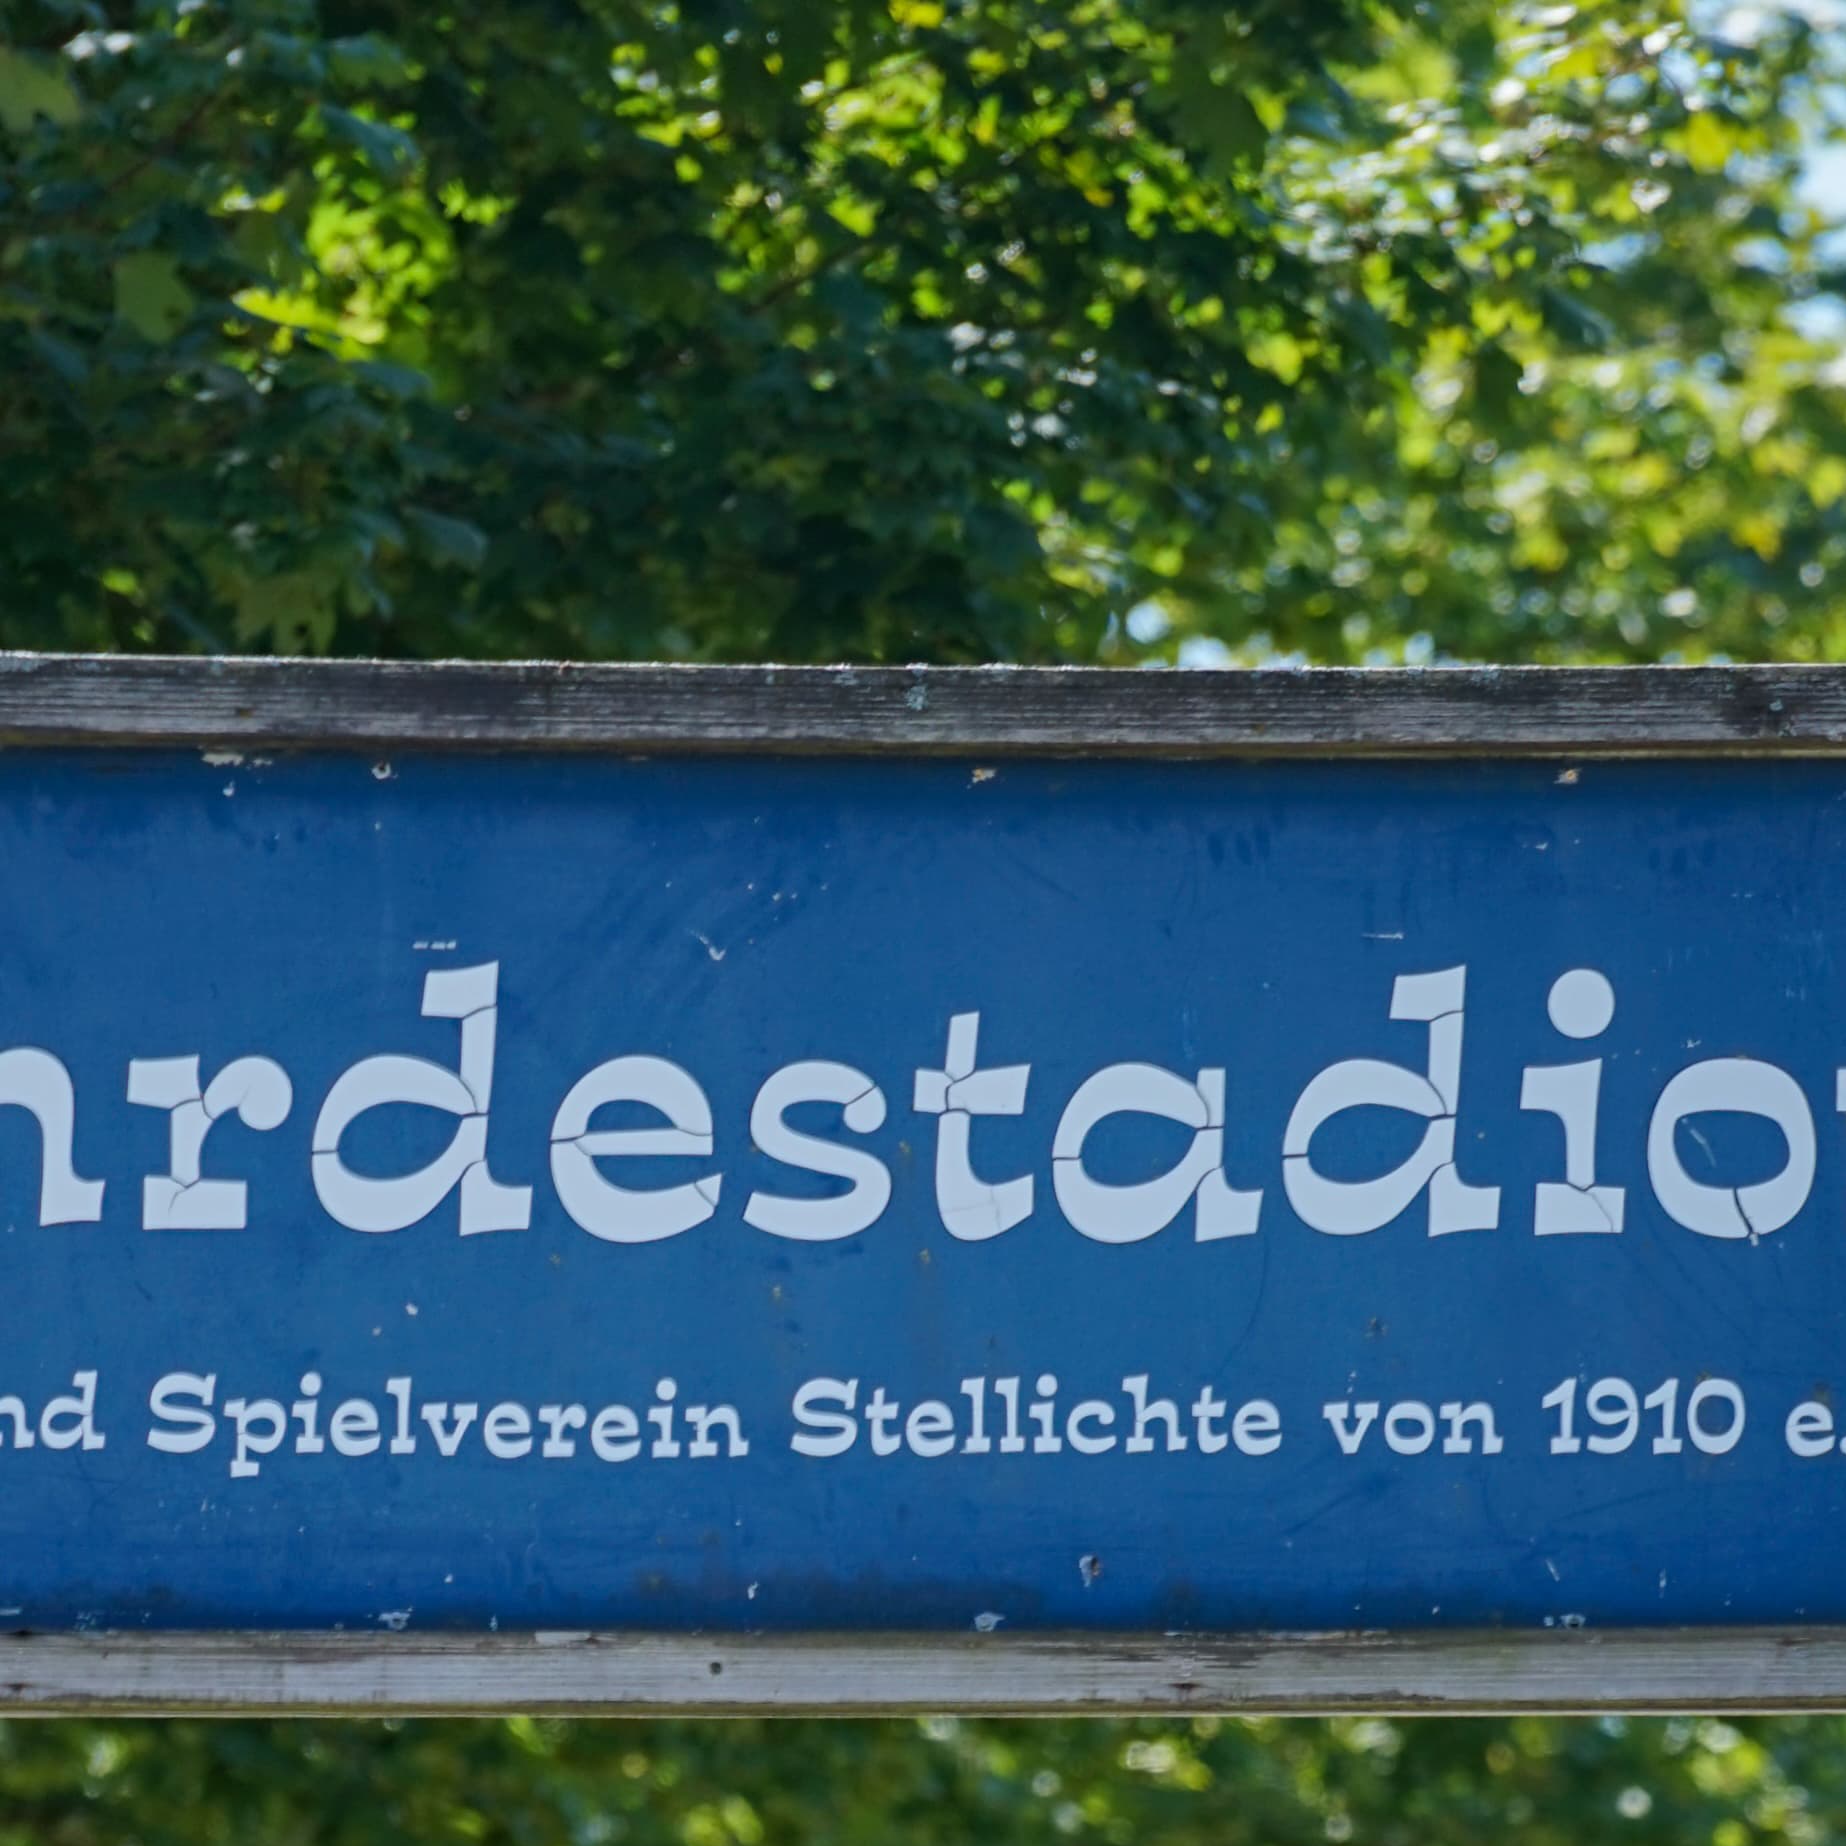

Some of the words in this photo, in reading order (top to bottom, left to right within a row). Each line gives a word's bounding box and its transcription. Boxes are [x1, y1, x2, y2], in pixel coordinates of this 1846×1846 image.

[147, 1372, 749, 1478] Spielverein
[790, 1374, 1282, 1457] Stellichte
[1323, 1401, 1503, 1455] von
[1542, 1377, 1745, 1455] 1910
